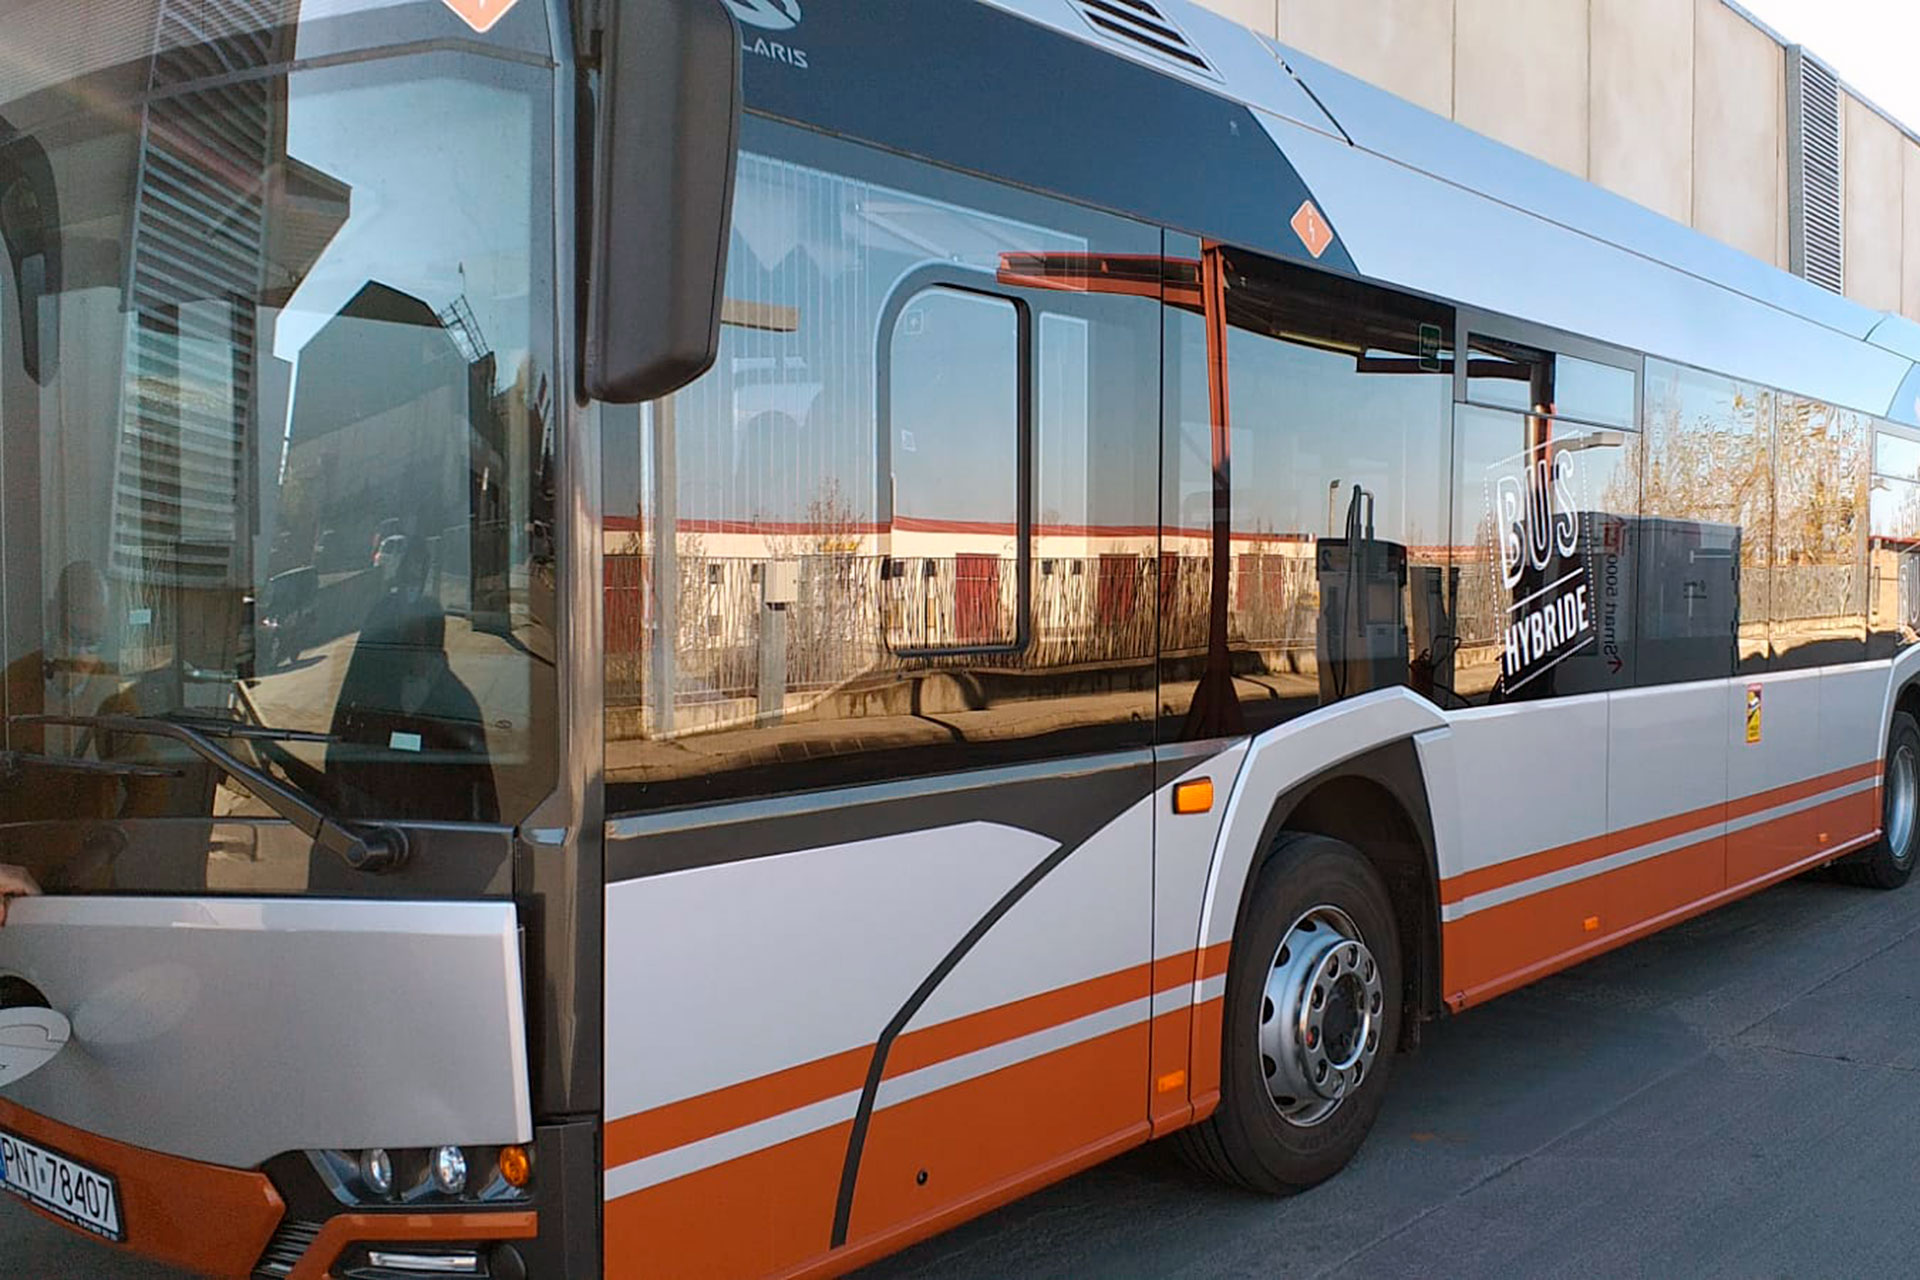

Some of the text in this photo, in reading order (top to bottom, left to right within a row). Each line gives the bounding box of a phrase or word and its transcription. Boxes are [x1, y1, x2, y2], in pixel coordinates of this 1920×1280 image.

[1497, 449, 1578, 590] BUS
[1504, 584, 1589, 677] HYBRIDE
[2, 1137, 110, 1222] PNT 78407
